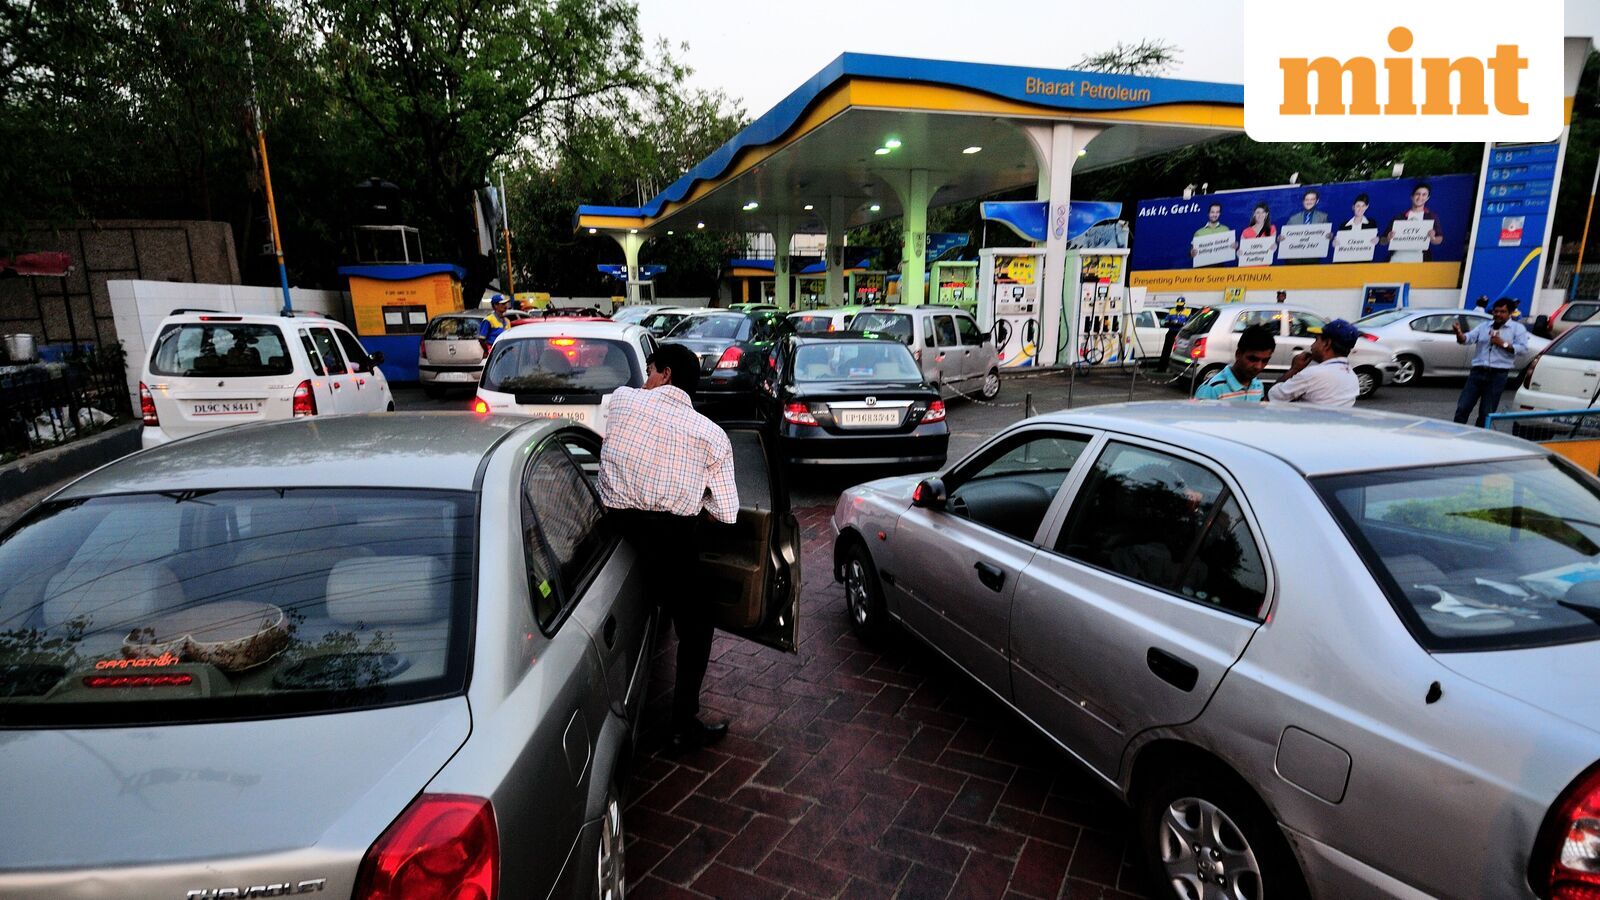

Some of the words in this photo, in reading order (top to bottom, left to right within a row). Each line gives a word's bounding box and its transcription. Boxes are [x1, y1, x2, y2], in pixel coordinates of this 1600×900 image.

[1025, 76, 1075, 97] Bharat
[1081, 81, 1150, 102] Petroleum
[1139, 206, 1156, 217] Ask
[1170, 204, 1188, 215] Get
[1134, 276, 1173, 286] Presenting
[1174, 275, 1192, 284] Pure
[1194, 273, 1205, 283] for
[1206, 273, 1225, 283] Sure
[194, 403, 220, 413] DL9C
[222, 403, 231, 412] N
[233, 402, 254, 411] 8441
[187, 878, 326, 900] CHEVROLET
